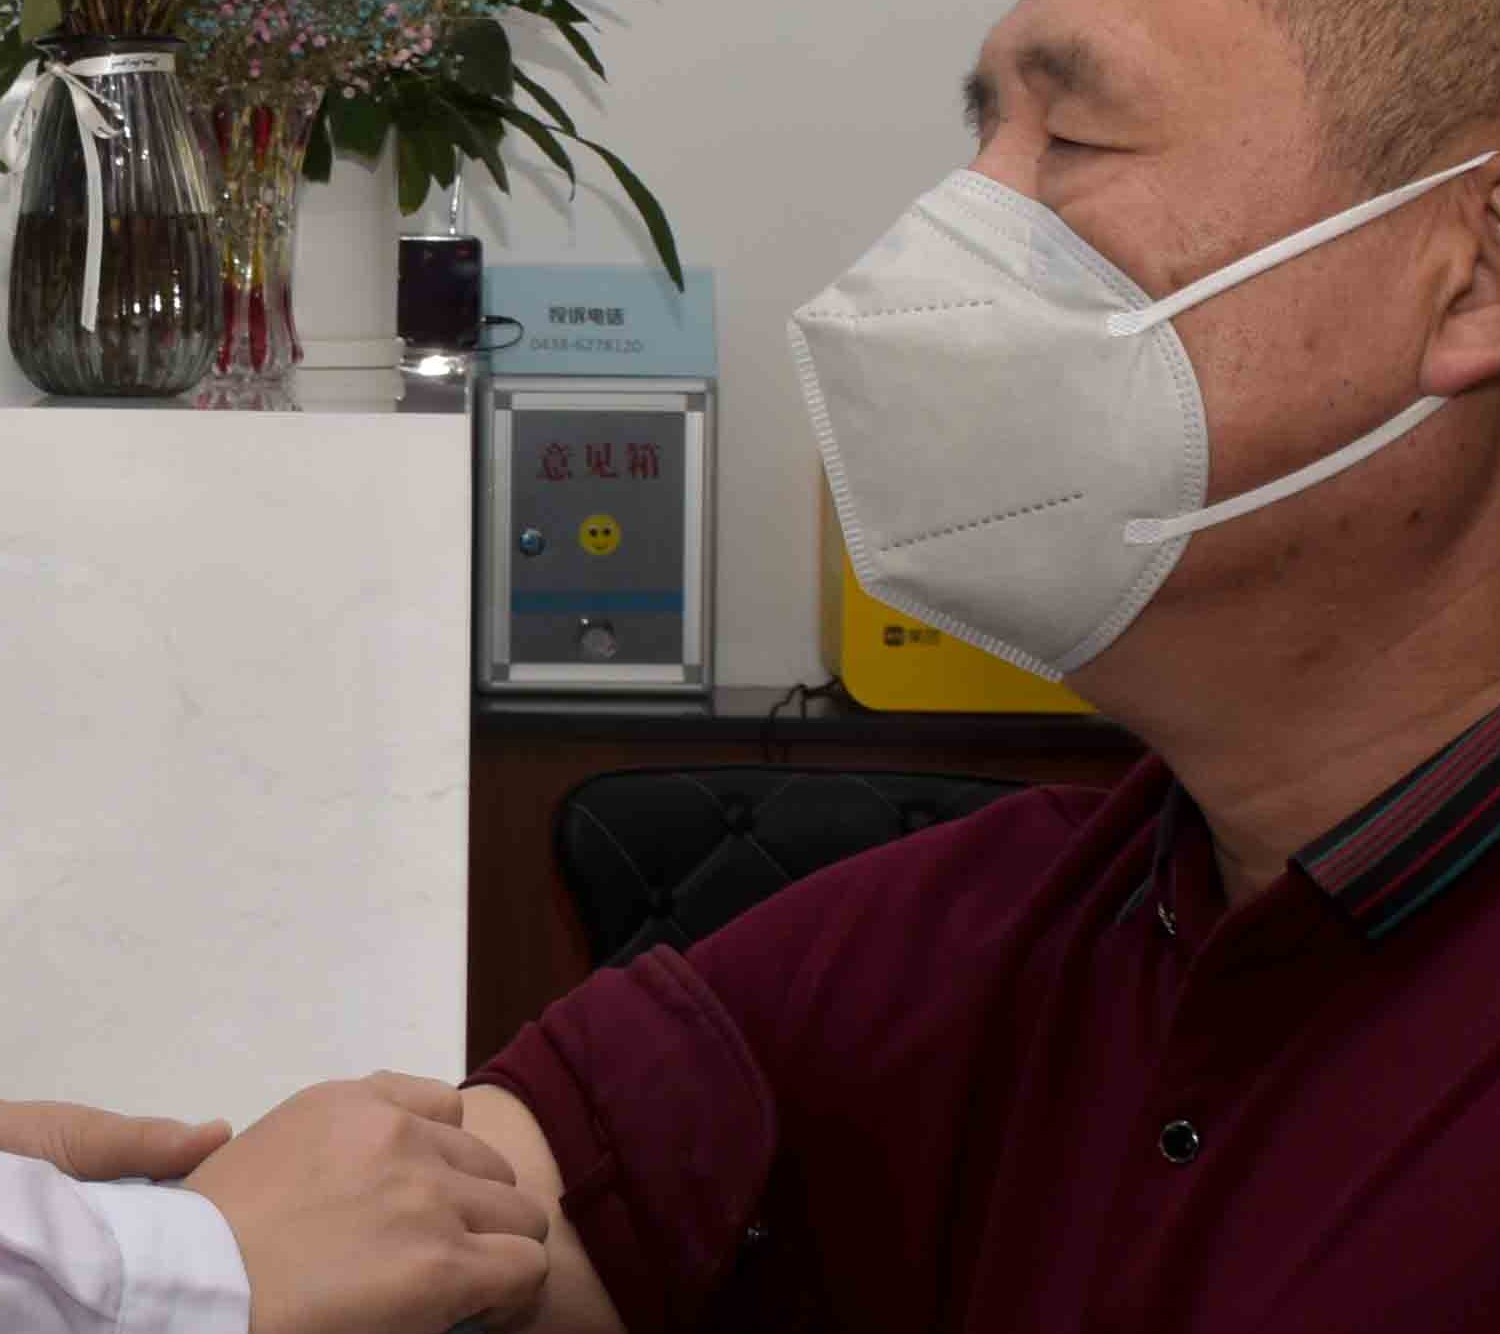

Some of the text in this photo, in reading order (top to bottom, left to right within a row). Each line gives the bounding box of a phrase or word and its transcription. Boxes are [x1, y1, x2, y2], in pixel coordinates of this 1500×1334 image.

[548, 306, 625, 326] 投诉电话
[536, 441, 662, 481] 意见箱
